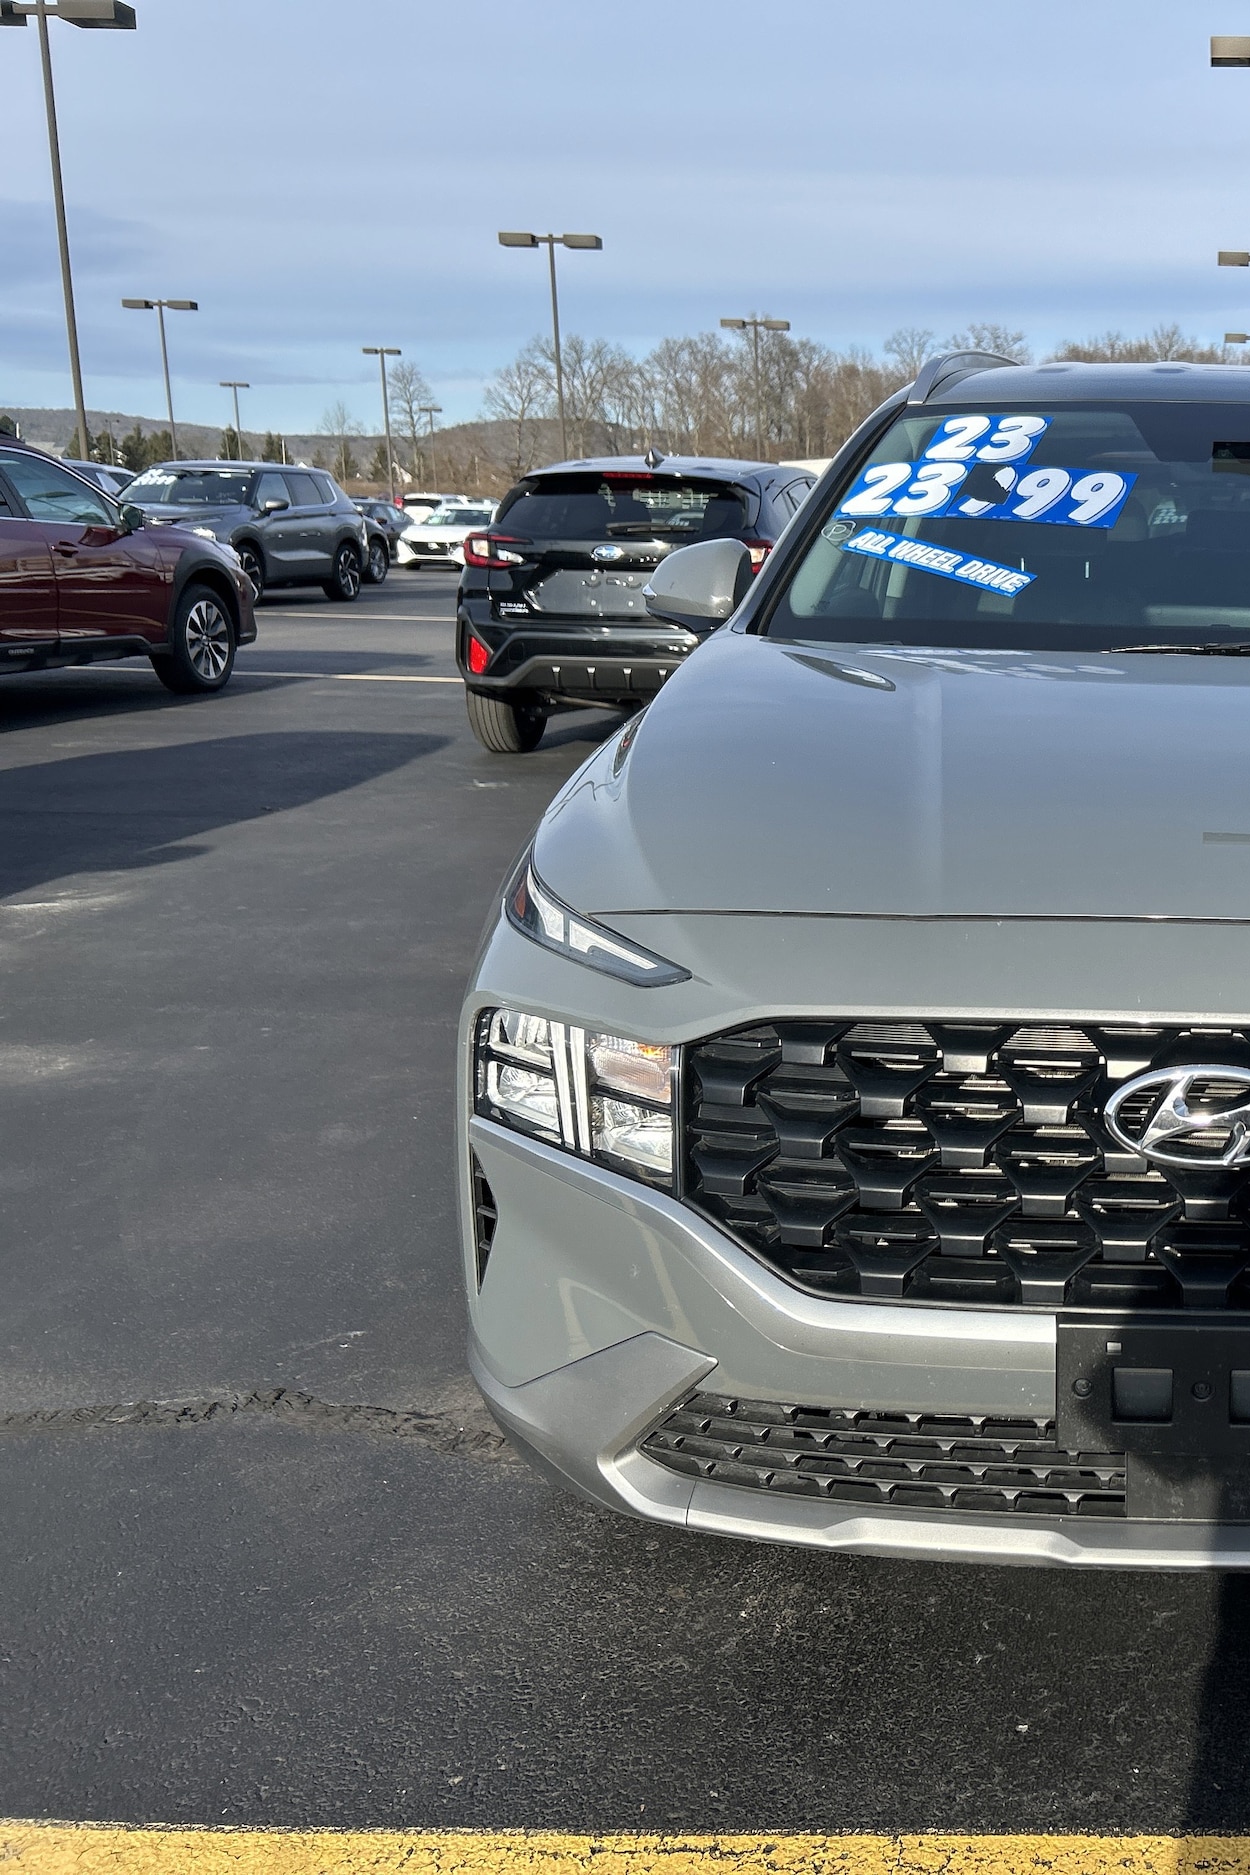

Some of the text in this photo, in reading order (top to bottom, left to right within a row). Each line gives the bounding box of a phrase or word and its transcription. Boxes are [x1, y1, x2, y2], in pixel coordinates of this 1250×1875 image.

[925, 416, 1049, 462] 23
[848, 530, 1031, 593] ALL WHEEL DRIVE
